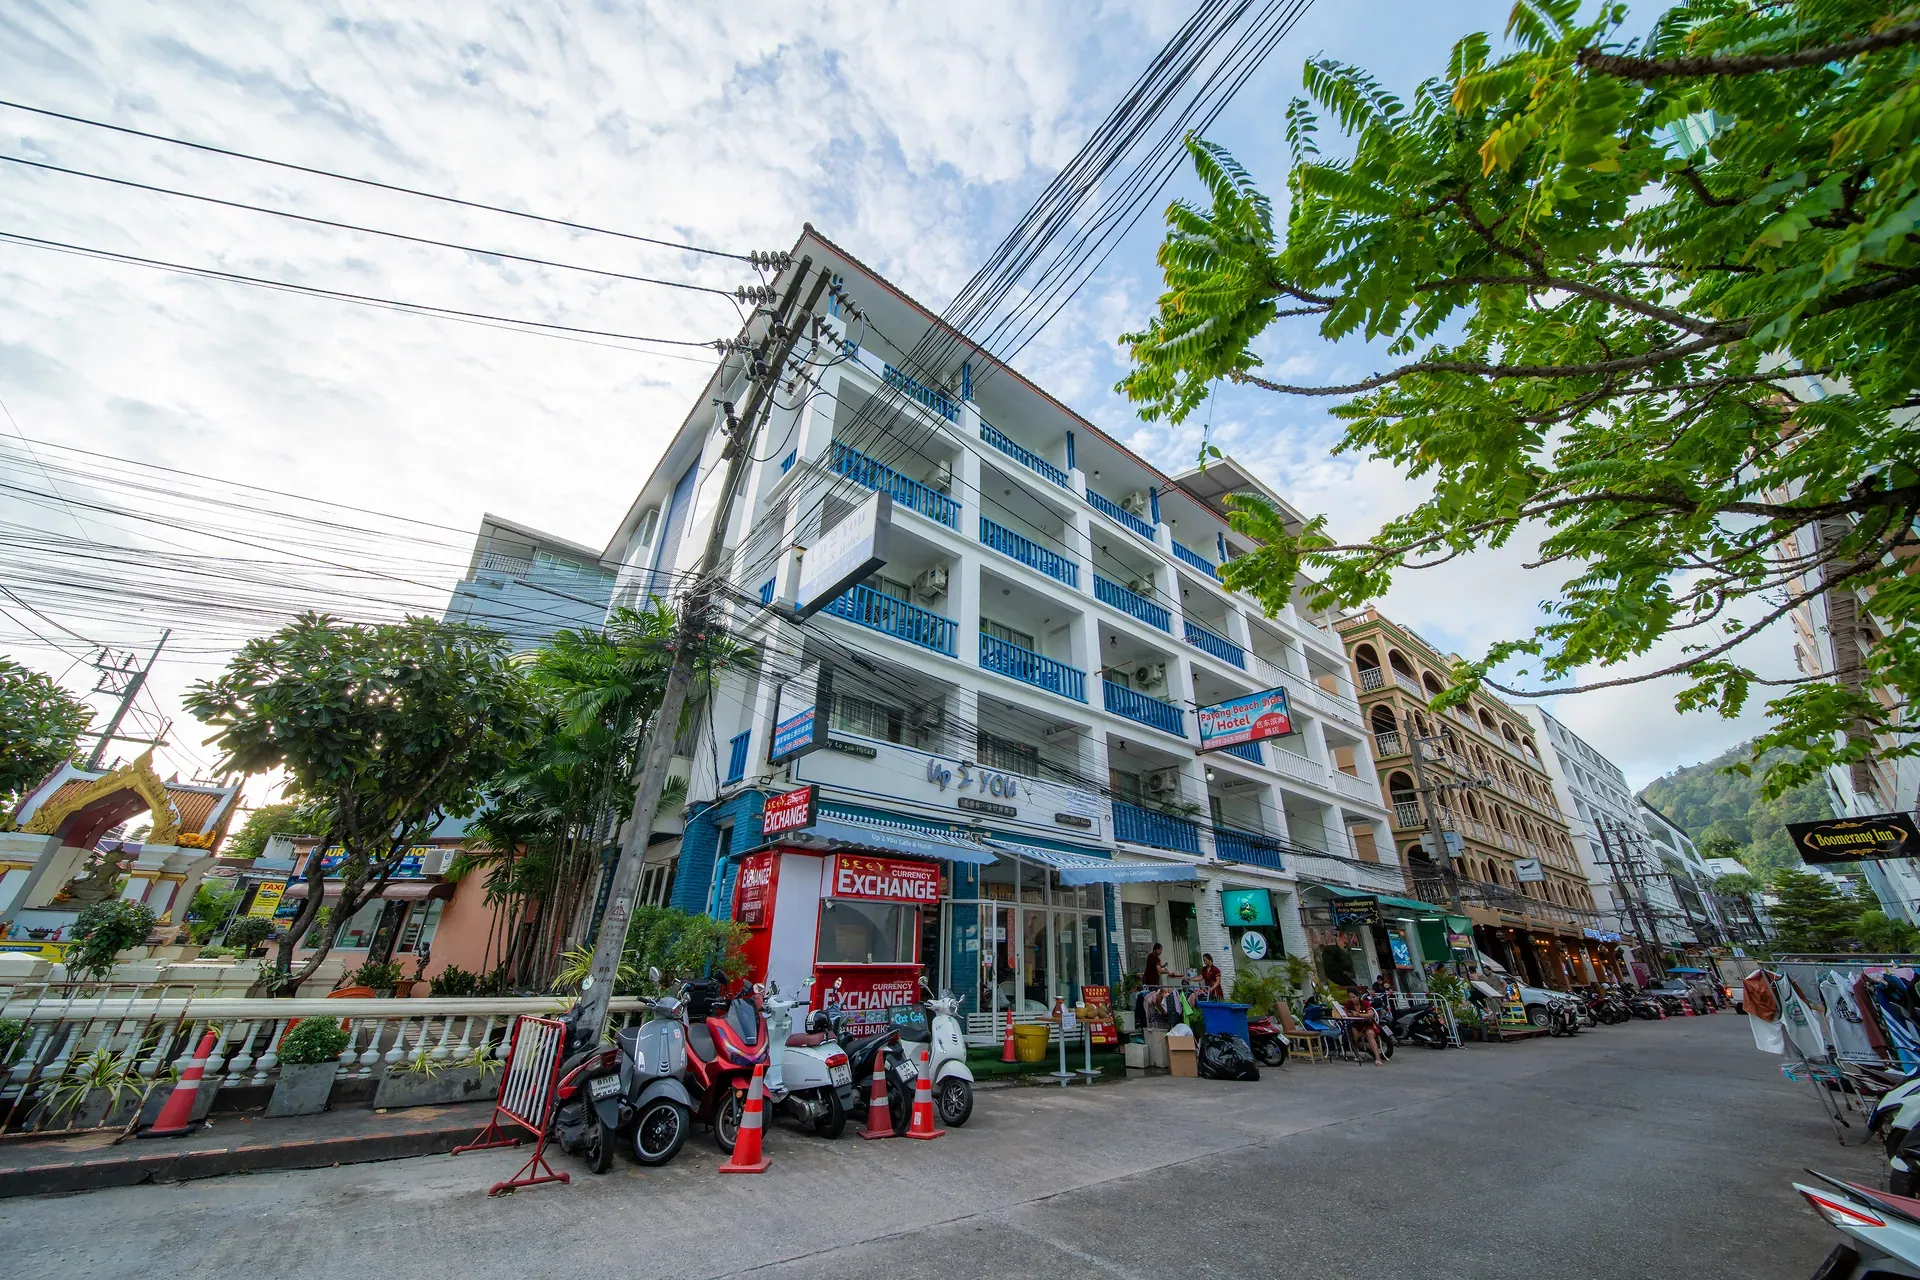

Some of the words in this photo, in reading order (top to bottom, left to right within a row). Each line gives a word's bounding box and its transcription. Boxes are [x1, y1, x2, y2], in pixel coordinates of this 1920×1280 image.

[1201, 709, 1231, 722] Patong
[1232, 701, 1260, 714] Beach
[1261, 695, 1282, 707] Side
[1217, 714, 1250, 731] Hotel
[957, 765, 974, 789] 2
[763, 804, 809, 833] EXCHANGE
[886, 836, 898, 844] You
[1815, 830, 1876, 846] Boomerang
[1871, 828, 1895, 841] Inn
[891, 870, 932, 880] CURRENCY
[263, 883, 284, 891] TAXI
[837, 869, 937, 900] EXCHANGE
[872, 983, 913, 991] CURRENCY
[823, 989, 913, 1011] EXCHANGE
